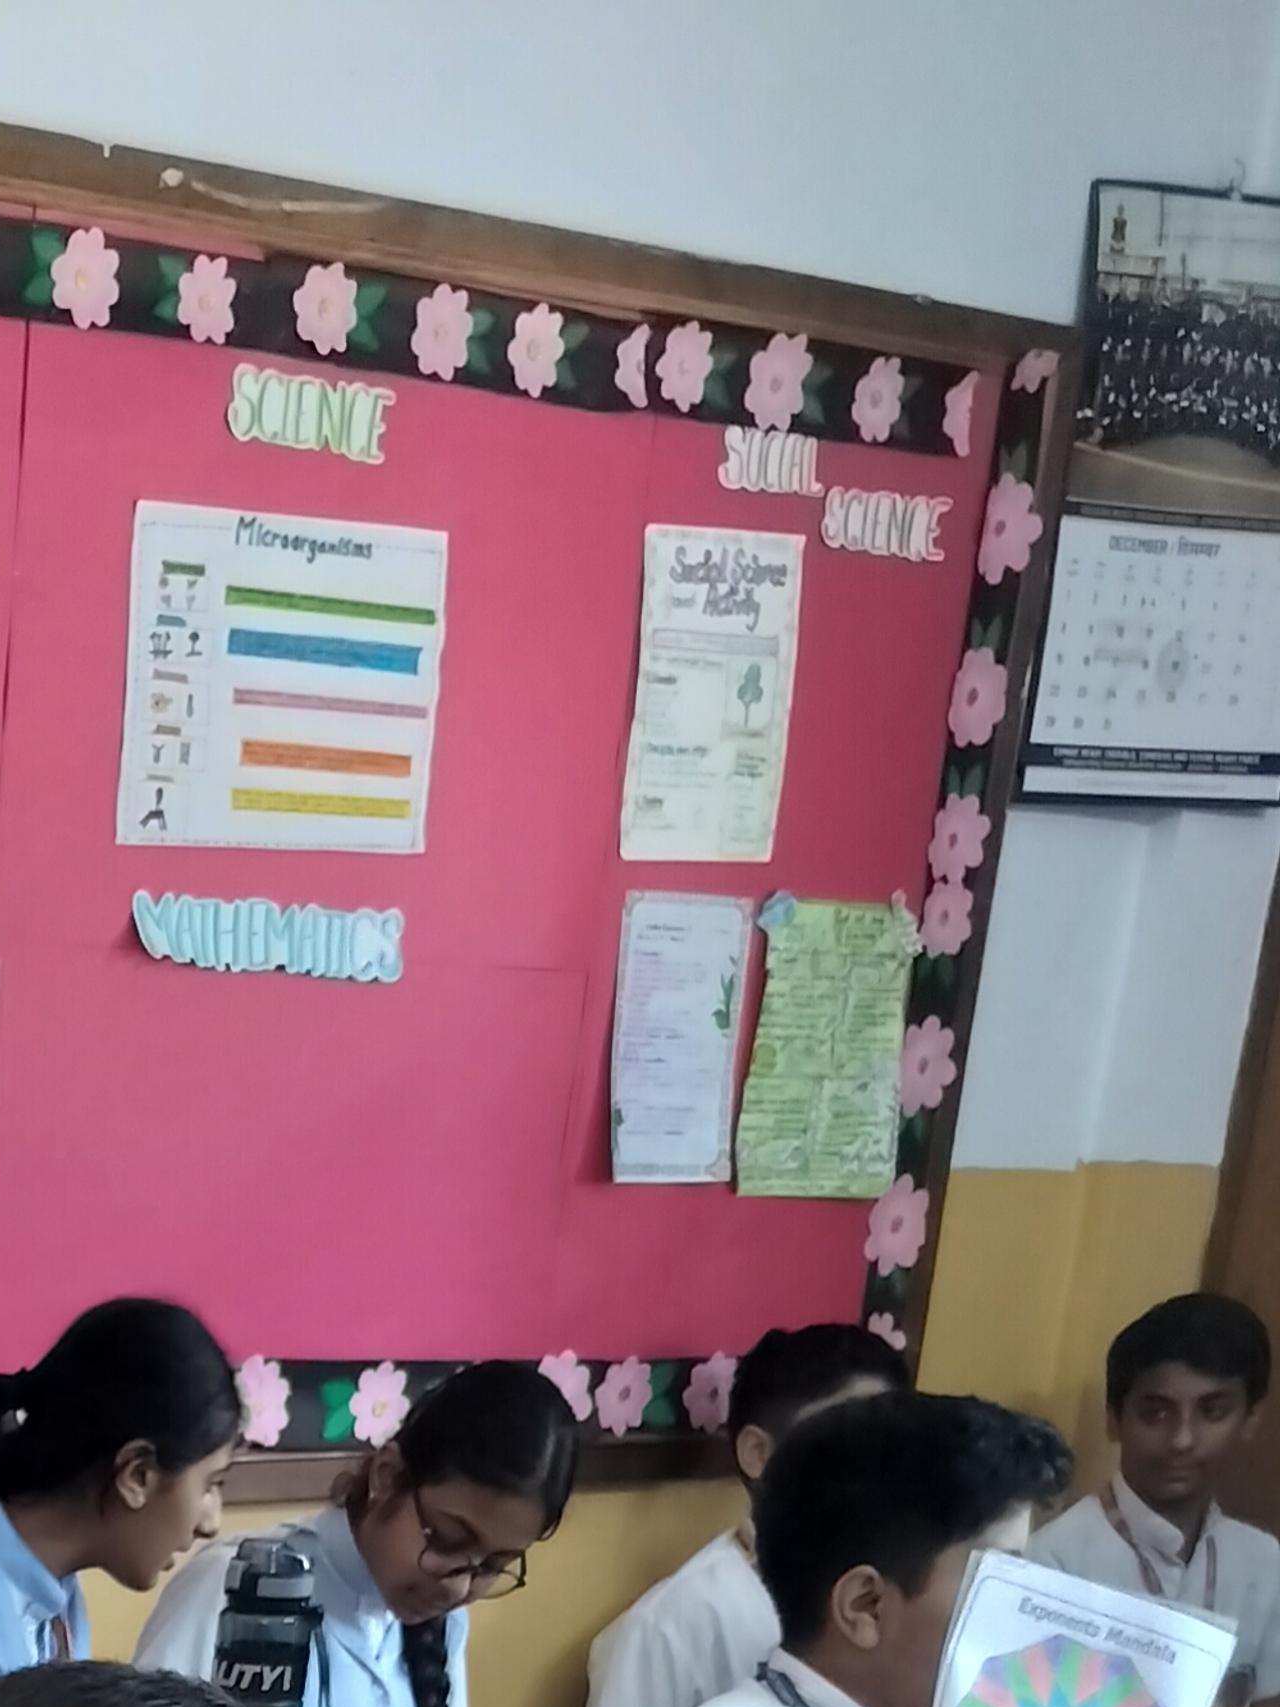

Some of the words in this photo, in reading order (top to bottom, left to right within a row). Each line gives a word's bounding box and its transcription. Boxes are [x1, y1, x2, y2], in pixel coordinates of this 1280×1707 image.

[230, 365, 394, 462] SCIENCE
[718, 425, 824, 497] SOCIAL
[822, 486, 952, 561] SCIENCE
[134, 890, 404, 982] MATHEMATICS
[1017, 1595, 1101, 1639] Exponents
[1104, 1625, 1177, 1665] Mandala
